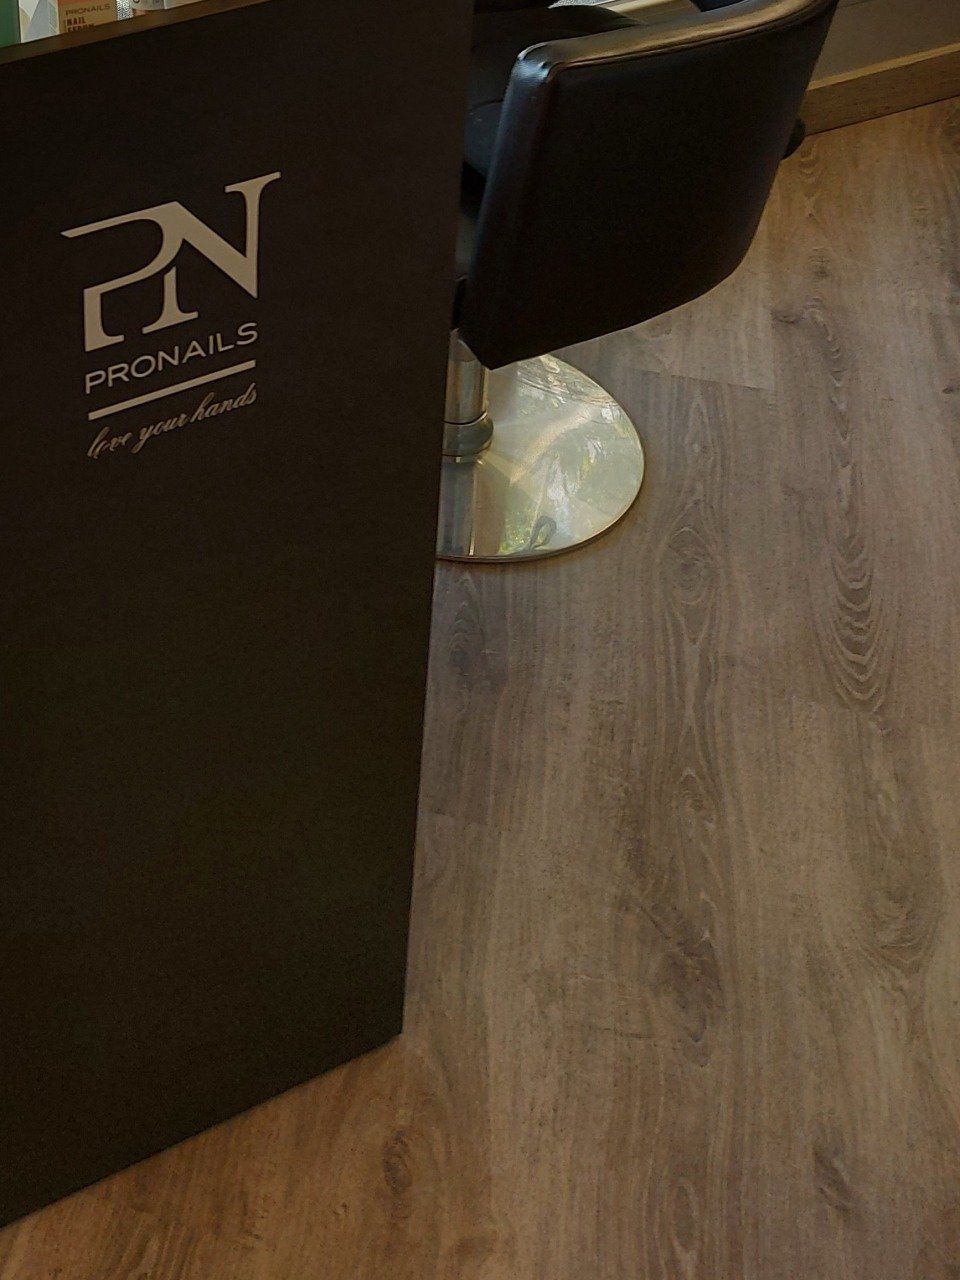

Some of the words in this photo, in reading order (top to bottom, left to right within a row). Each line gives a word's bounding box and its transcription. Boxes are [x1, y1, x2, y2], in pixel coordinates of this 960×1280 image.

[85, 322, 258, 395] PRONAILS
[131, 413, 189, 454] your
[189, 382, 258, 423] hands
